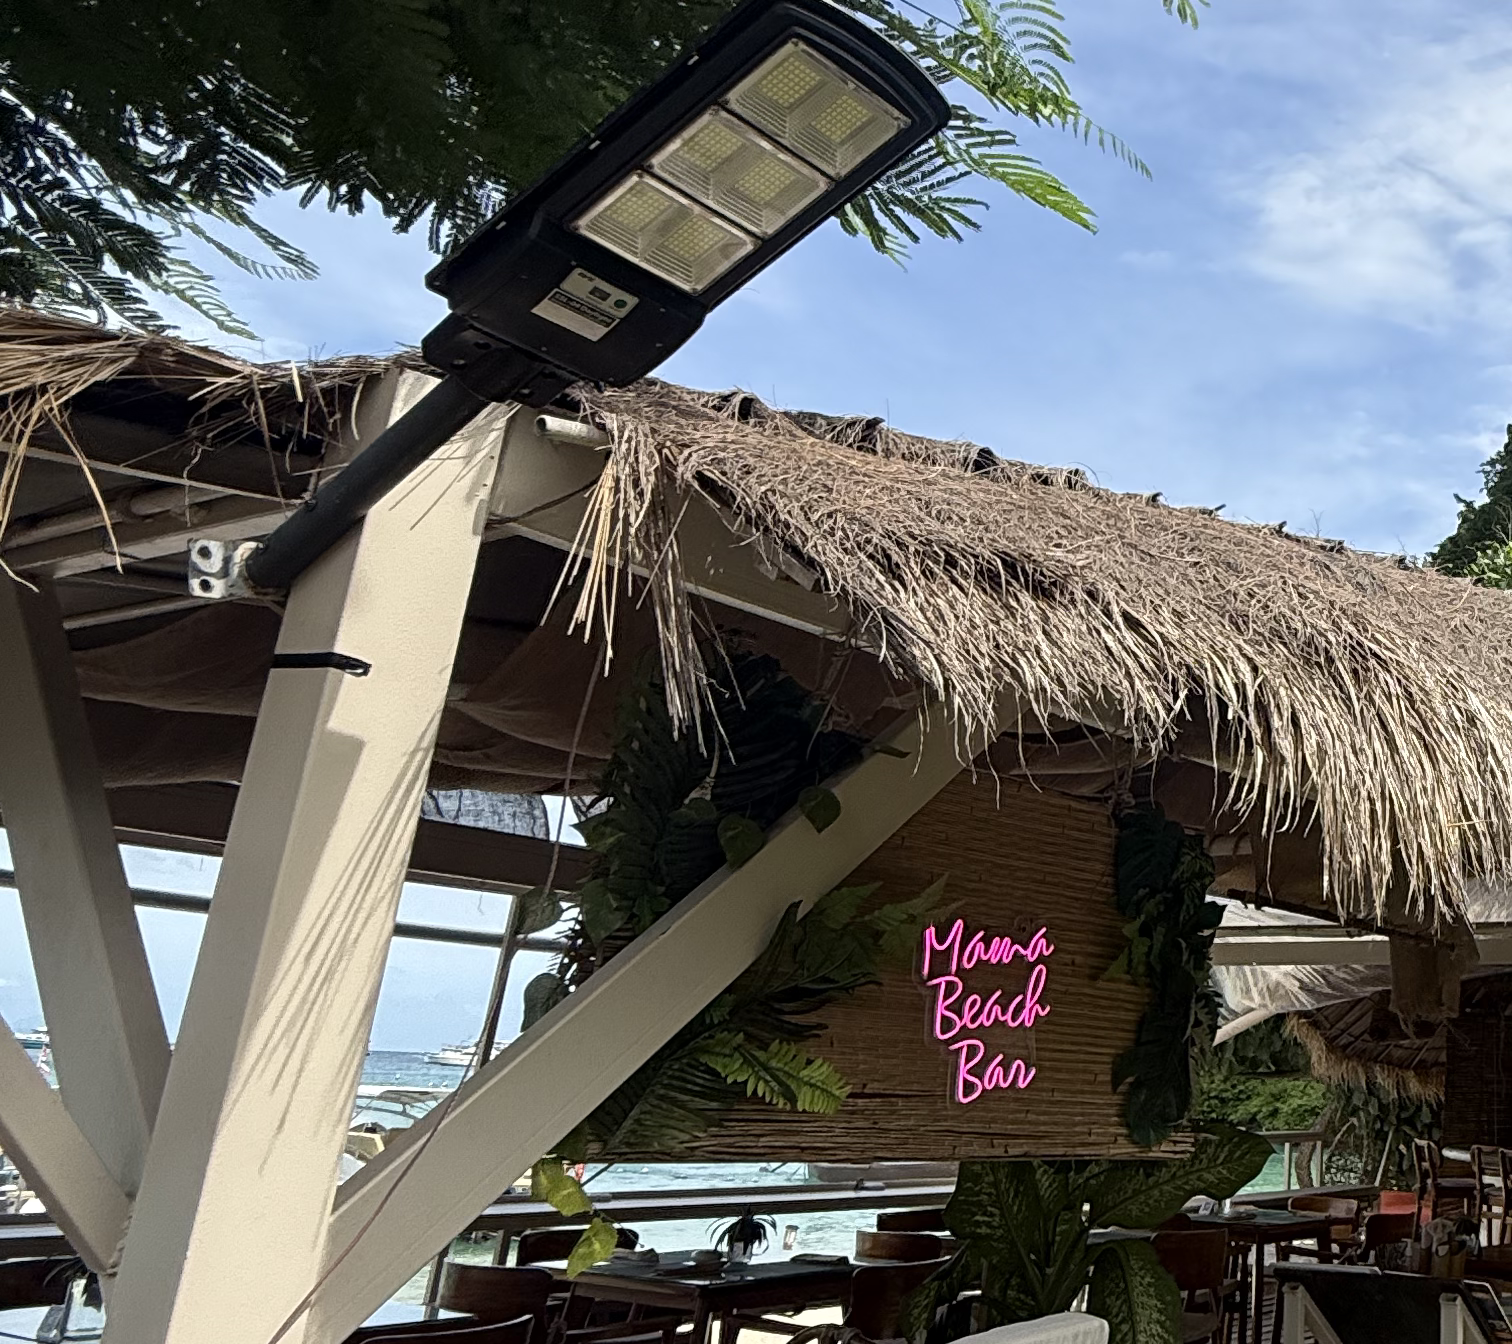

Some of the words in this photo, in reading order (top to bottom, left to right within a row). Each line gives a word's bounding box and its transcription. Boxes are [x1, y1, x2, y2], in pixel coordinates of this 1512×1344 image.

[924, 919, 1054, 978] Mama
[926, 964, 1050, 1040] Beach
[948, 1039, 1036, 1104] Bar
